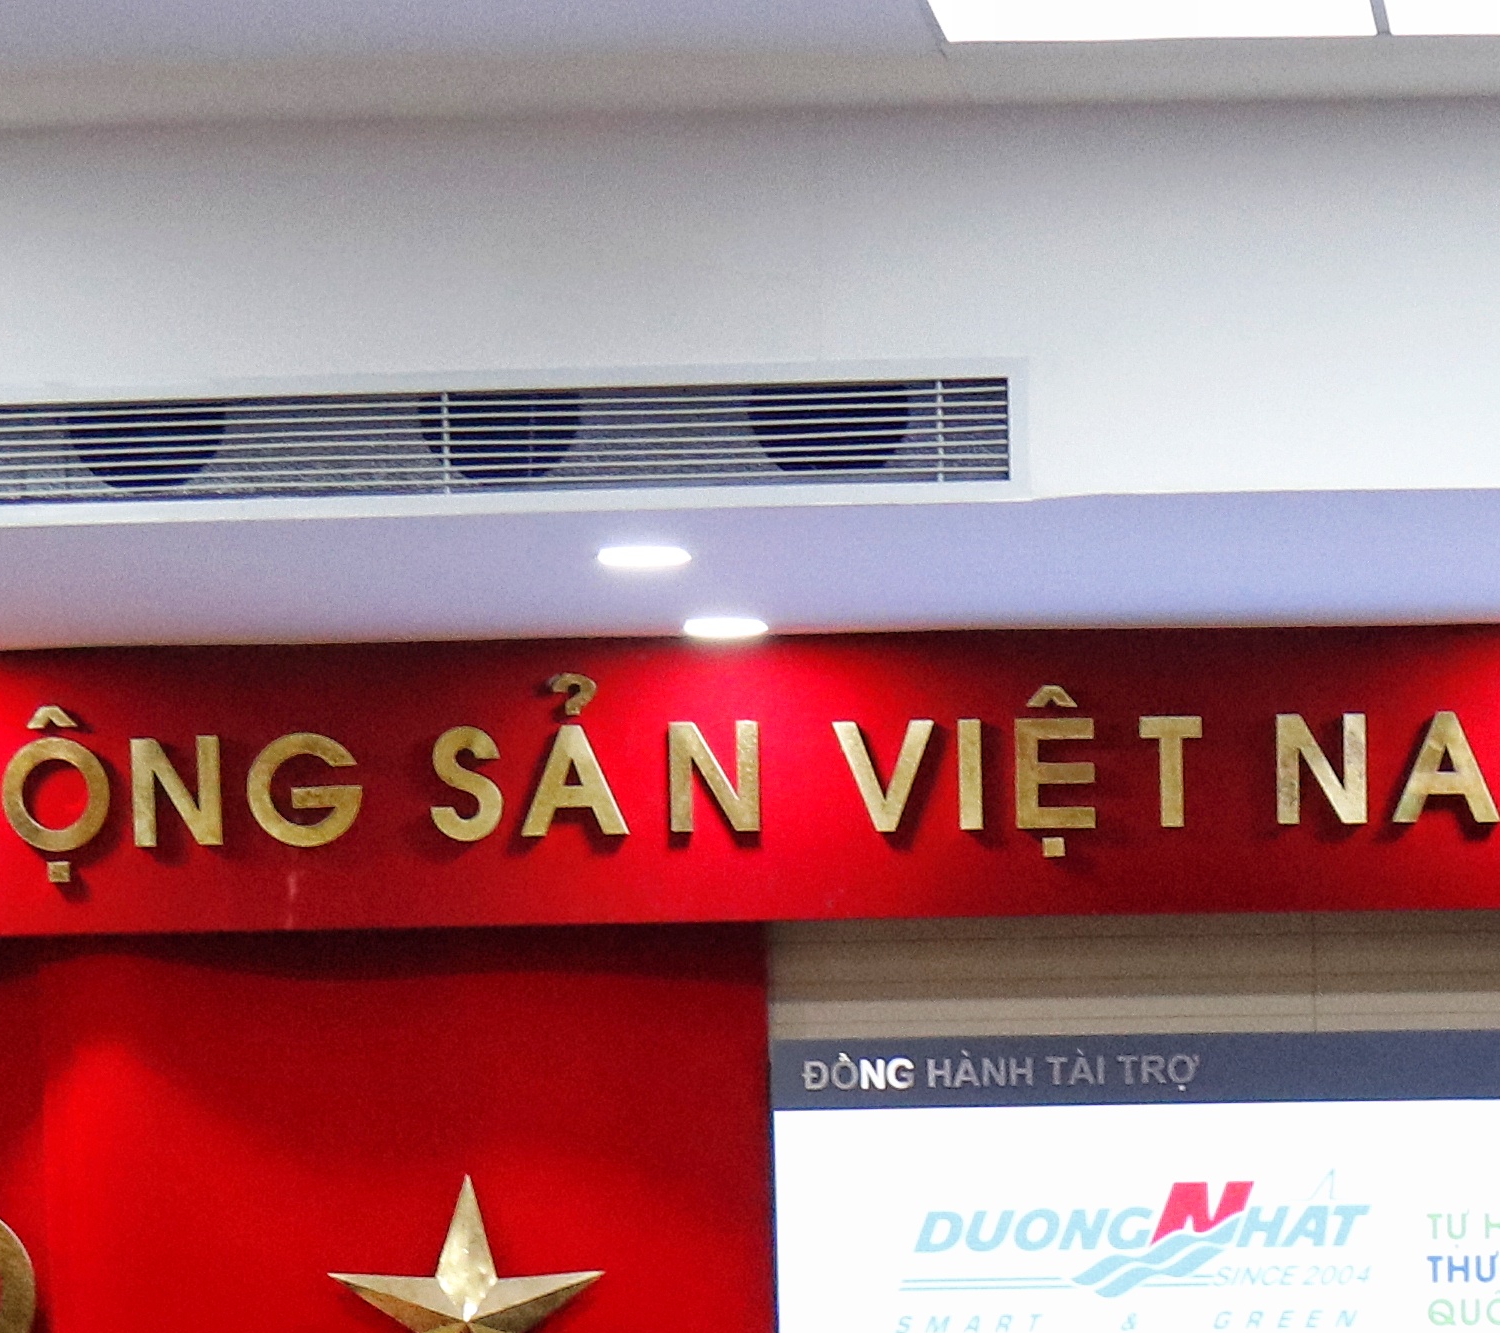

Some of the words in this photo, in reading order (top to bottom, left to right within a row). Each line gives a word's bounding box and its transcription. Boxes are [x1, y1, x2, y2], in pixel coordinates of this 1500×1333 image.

[430, 672, 760, 842] SẢN
[831, 684, 1202, 858] VIỆT
[803, 1052, 915, 1091] ĐỒNG
[926, 1050, 1034, 1088] HÀNH
[1047, 1048, 1104, 1086] TÀI
[1117, 1053, 1199, 1091] TRỢ
[1427, 1210, 1469, 1248] TỰ
[1214, 1265, 1297, 1286] SINCE
[1303, 1263, 1372, 1285] 2004
[1120, 1313, 1138, 1331] &
[1213, 1309, 1358, 1330] GREEN
